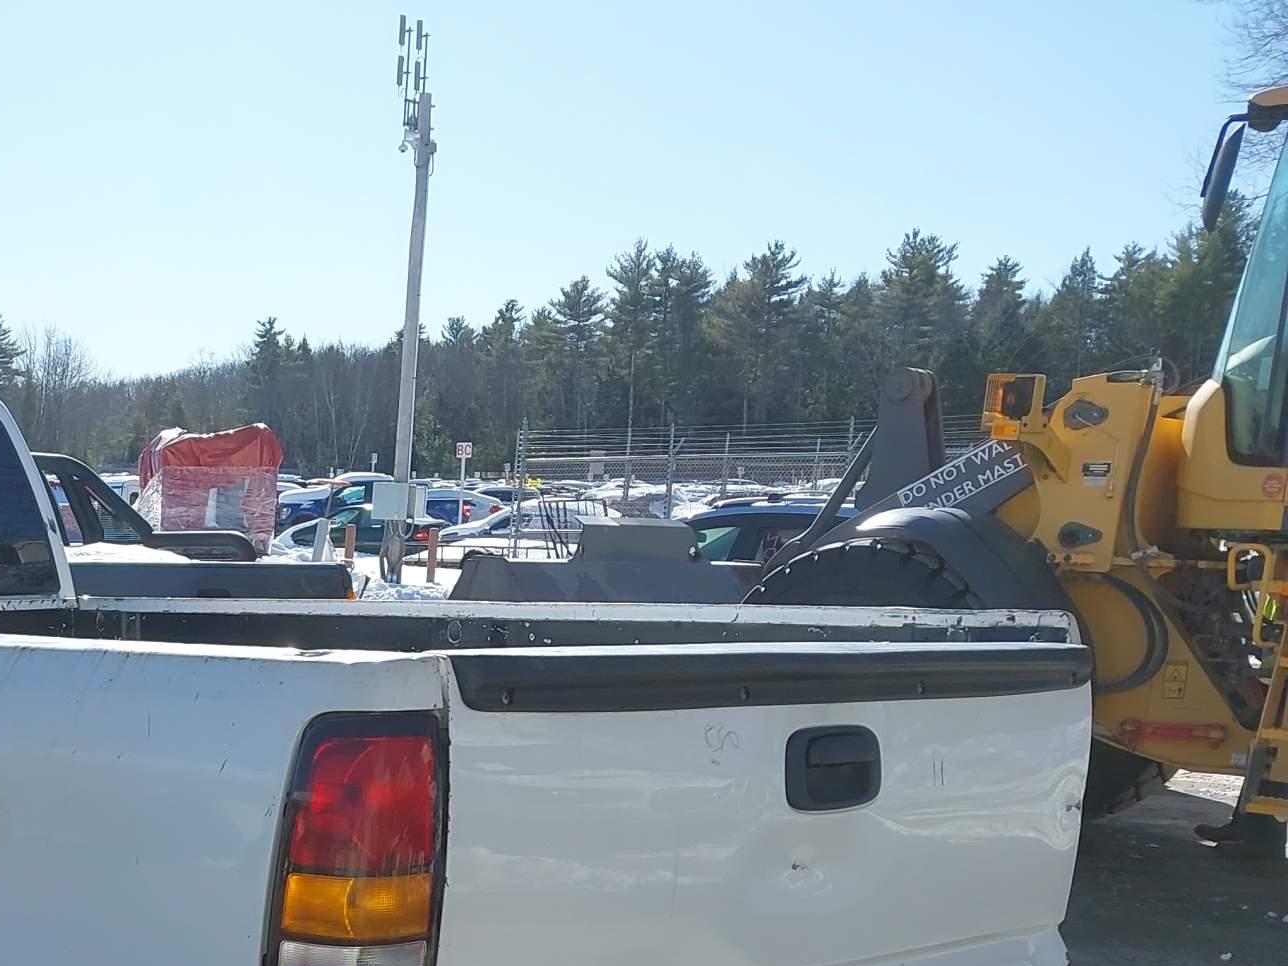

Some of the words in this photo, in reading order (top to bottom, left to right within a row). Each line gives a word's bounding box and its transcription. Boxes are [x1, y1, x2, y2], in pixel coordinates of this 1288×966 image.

[457, 444, 472, 456] BC
[899, 483, 927, 505] DO
[930, 460, 967, 489] NOT
[971, 440, 1013, 466] WAL
[924, 480, 977, 508] NDER
[977, 453, 1025, 487] MAST
